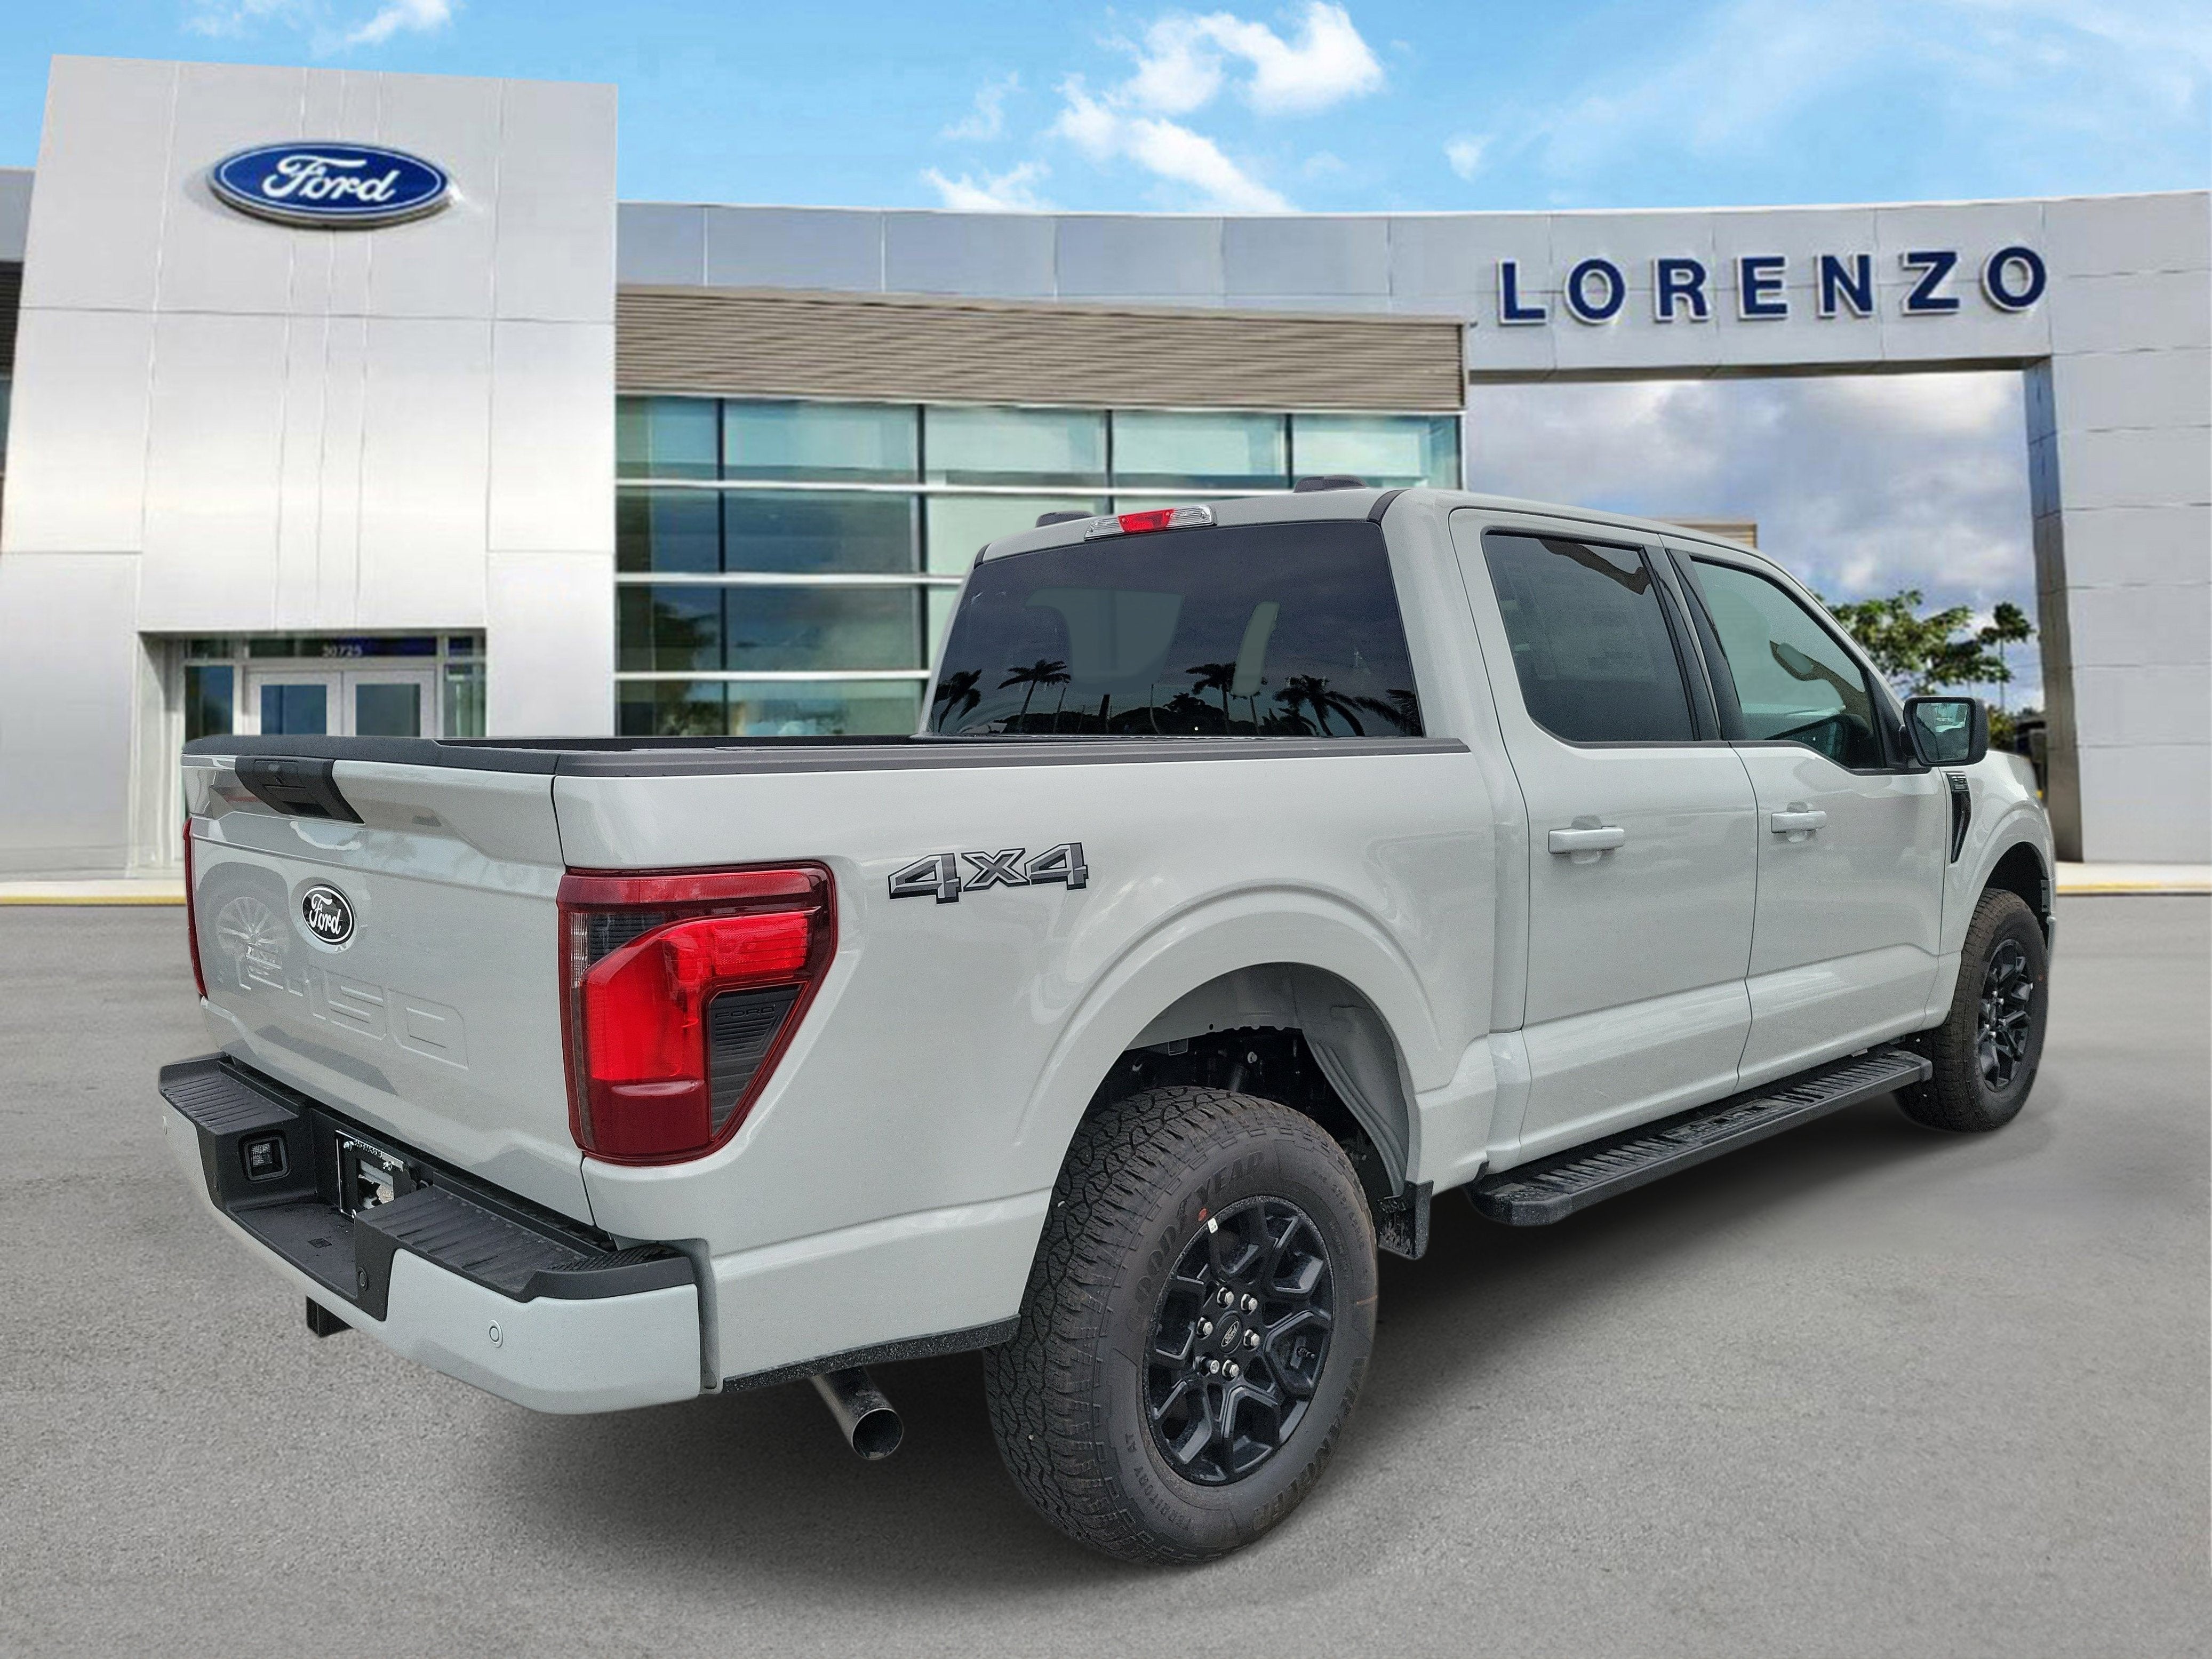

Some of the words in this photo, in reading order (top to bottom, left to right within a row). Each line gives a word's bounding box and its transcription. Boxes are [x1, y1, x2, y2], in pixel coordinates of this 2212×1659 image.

[262, 154, 400, 202] Ford
[1499, 246, 2047, 324] LORENZO
[308, 893, 342, 935] Ford
[715, 1006, 774, 1020] FORD
[1133, 1466, 1192, 1531] TERRITORY
